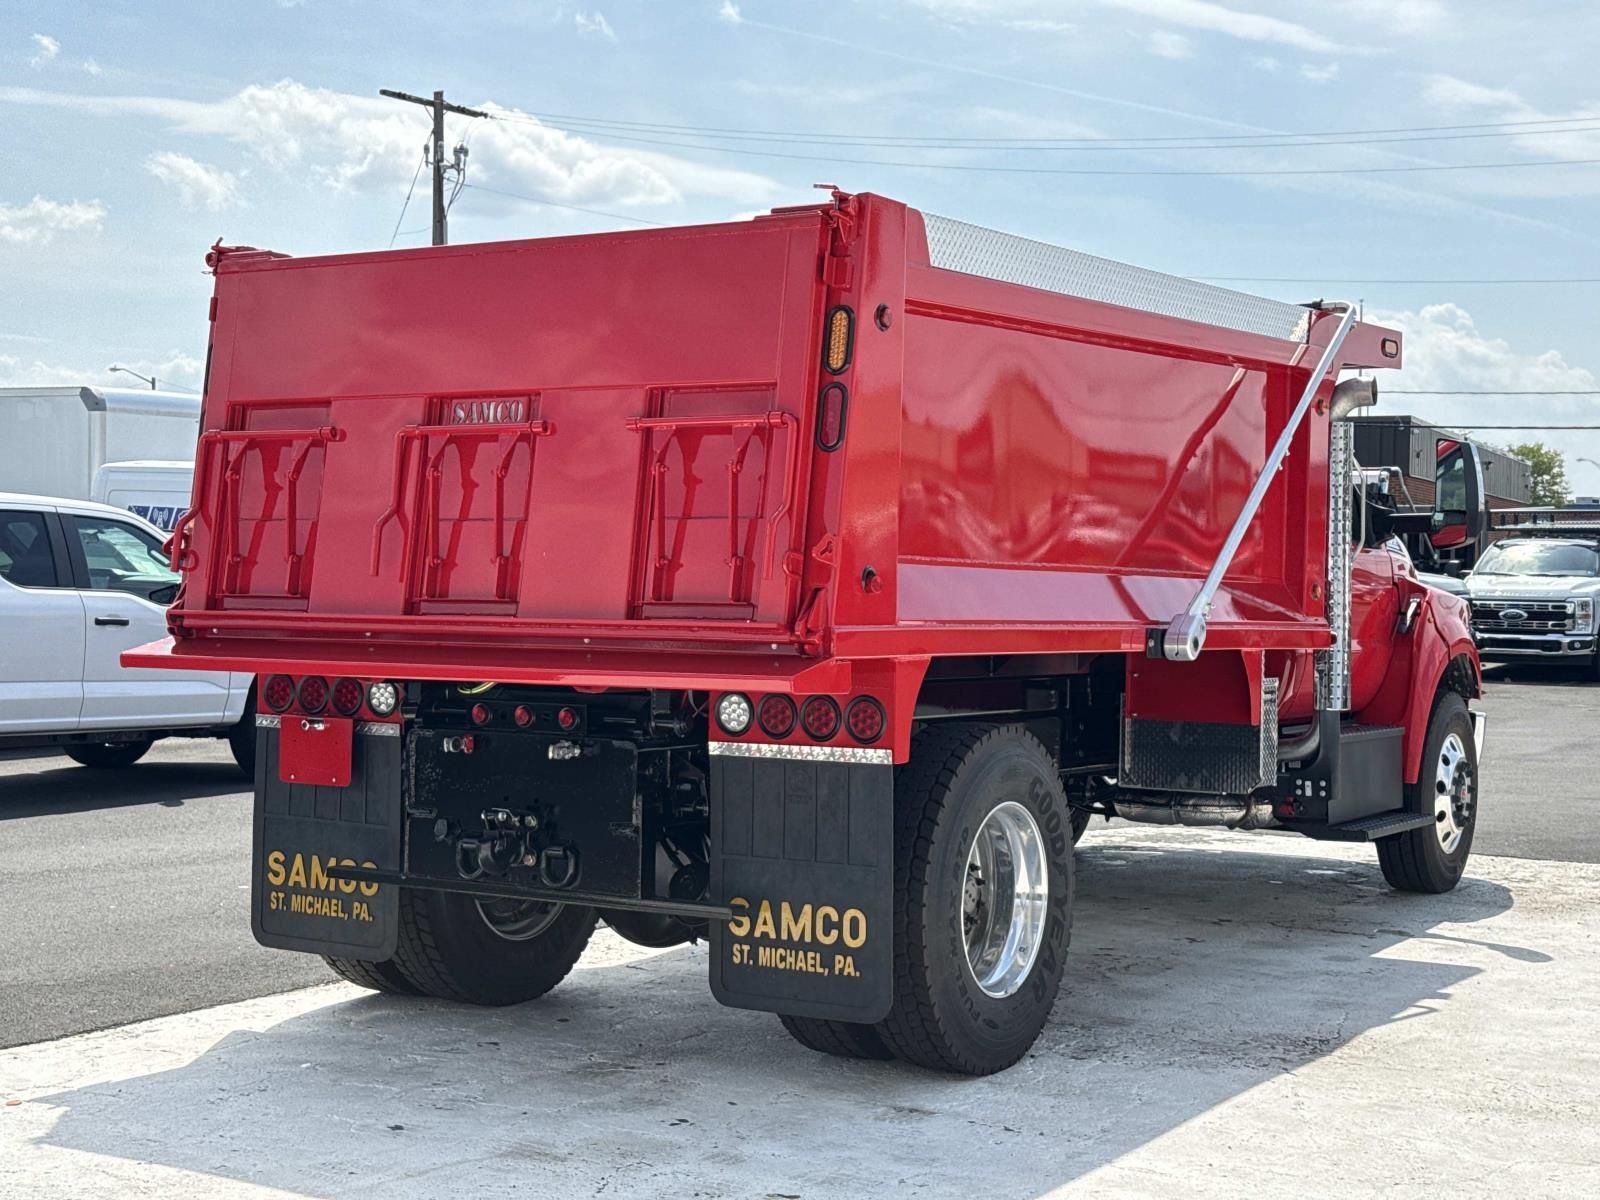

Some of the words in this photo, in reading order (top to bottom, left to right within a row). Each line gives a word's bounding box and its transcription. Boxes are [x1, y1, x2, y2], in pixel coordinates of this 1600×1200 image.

[454, 399, 523, 424] SAMCO
[267, 850, 379, 897] SAMCO
[1028, 775, 1068, 1004] GOODYEAR
[270, 890, 287, 911] ST.
[291, 894, 349, 920] MICHAEL,
[352, 901, 374, 921] PA.
[728, 896, 867, 948] SAMCO
[732, 943, 753, 965] ST.
[758, 946, 829, 976] MICHAEL,
[834, 954, 861, 977] PA.
